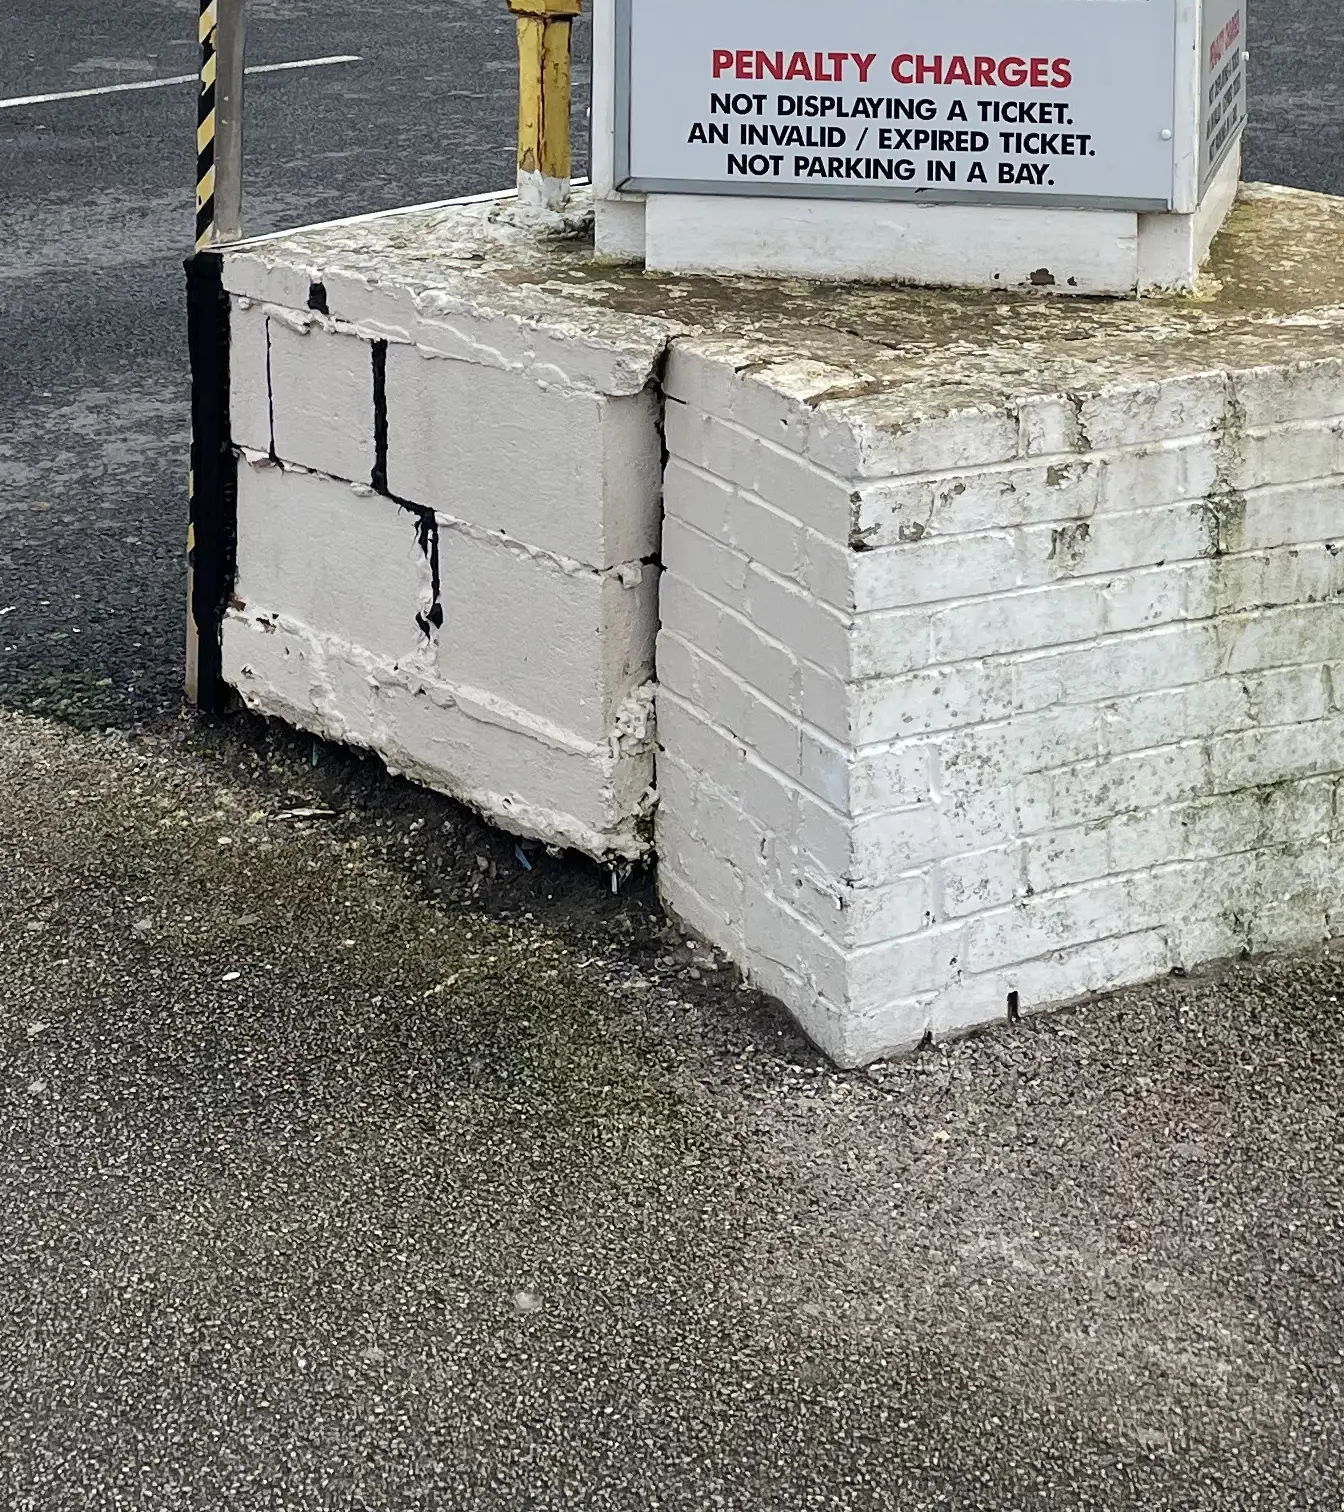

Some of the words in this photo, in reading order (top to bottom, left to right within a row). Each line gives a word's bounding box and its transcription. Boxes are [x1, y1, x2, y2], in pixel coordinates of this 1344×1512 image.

[712, 49, 876, 82] PENALTY
[891, 53, 1072, 88] CHARGES
[710, 93, 770, 116] NOT
[777, 95, 938, 121] DISPLAYING
[947, 100, 968, 121] A
[976, 101, 1073, 124] TICKET.
[688, 122, 731, 145] AN
[739, 124, 846, 148] INVALID
[877, 128, 988, 153] EXPIRED
[999, 132, 1095, 156] TICKET.
[727, 154, 786, 176] NOT
[794, 156, 918, 181] PARKING
[927, 160, 956, 182] IN
[967, 161, 988, 183] A
[997, 162, 1054, 185] BAY.
